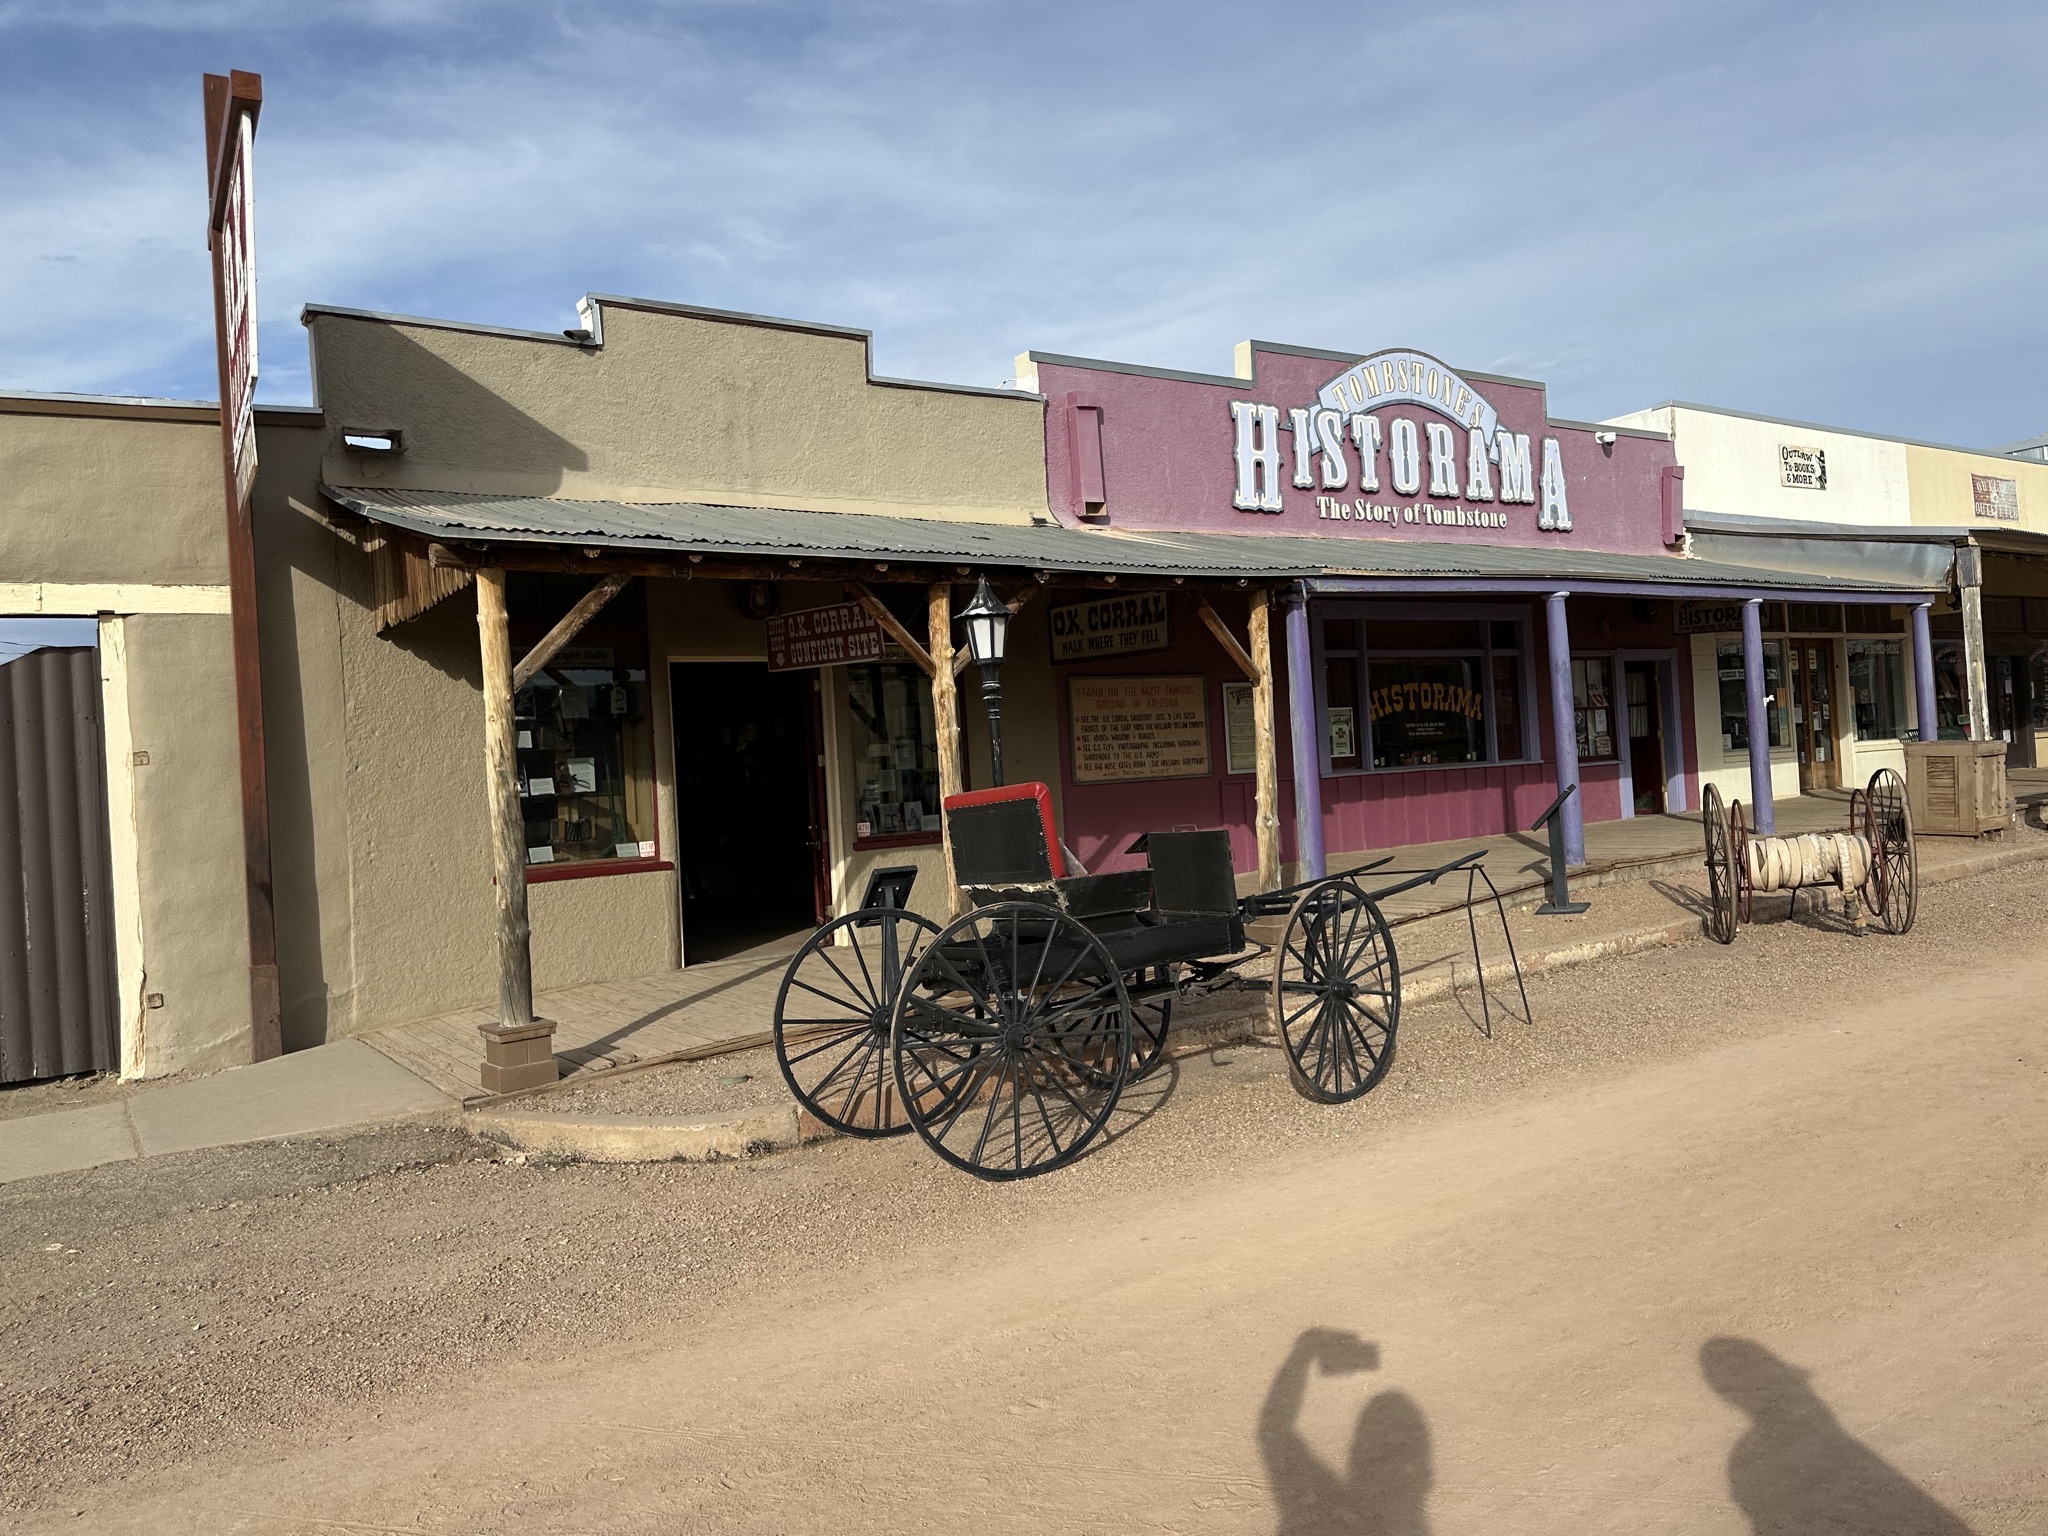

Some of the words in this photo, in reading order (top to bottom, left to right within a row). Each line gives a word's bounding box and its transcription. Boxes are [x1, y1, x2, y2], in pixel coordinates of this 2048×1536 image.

[1330, 359, 1485, 429] TOMBSTONE'S
[1229, 400, 1573, 532] HISTORAMA
[1786, 473, 1792, 483] &
[1792, 473, 1813, 484] MORE
[1316, 496, 1350, 520] The
[1354, 499, 1400, 527] Story
[1404, 502, 1421, 523] of
[1423, 503, 1508, 529] Tombstone
[788, 615, 812, 638] O.K.
[813, 606, 875, 634] CORRAL
[1053, 608, 1084, 637] O.K.
[1088, 595, 1166, 632] CORRAL
[1088, 634, 1114, 651] WHERE
[1119, 631, 1138, 647] THEY
[790, 637, 844, 664] GUNFIGHT
[847, 632, 880, 657] SITE
[583, 650, 608, 660] Studio
[1076, 687, 1103, 697] STAND
[1108, 686, 1119, 696] ON
[1124, 686, 1138, 696] THE
[1141, 686, 1161, 696] MOST
[1165, 685, 1194, 695] FAMOUS
[1096, 699, 1126, 710] GROUND
[1133, 699, 1141, 709] IN
[1146, 698, 1179, 708] ARIZONA
[1370, 682, 1483, 722] HISTORAMA
[1081, 715, 1090, 723] SEE
[1091, 715, 1100, 723] THE
[1112, 714, 1129, 722] CORRAL
[1102, 724, 1108, 732] OF
[1110, 723, 1119, 731] THE
[1121, 723, 1132, 731] EARP
[1082, 734, 1090, 742] SEE
[1083, 744, 1091, 752] SEE
[1153, 740, 1176, 749] INCLUDING
[1113, 752, 1120, 760] TO
[1123, 752, 1132, 760] THE
[1084, 762, 1092, 771] SEE
[641, 842, 655, 851] ATM
